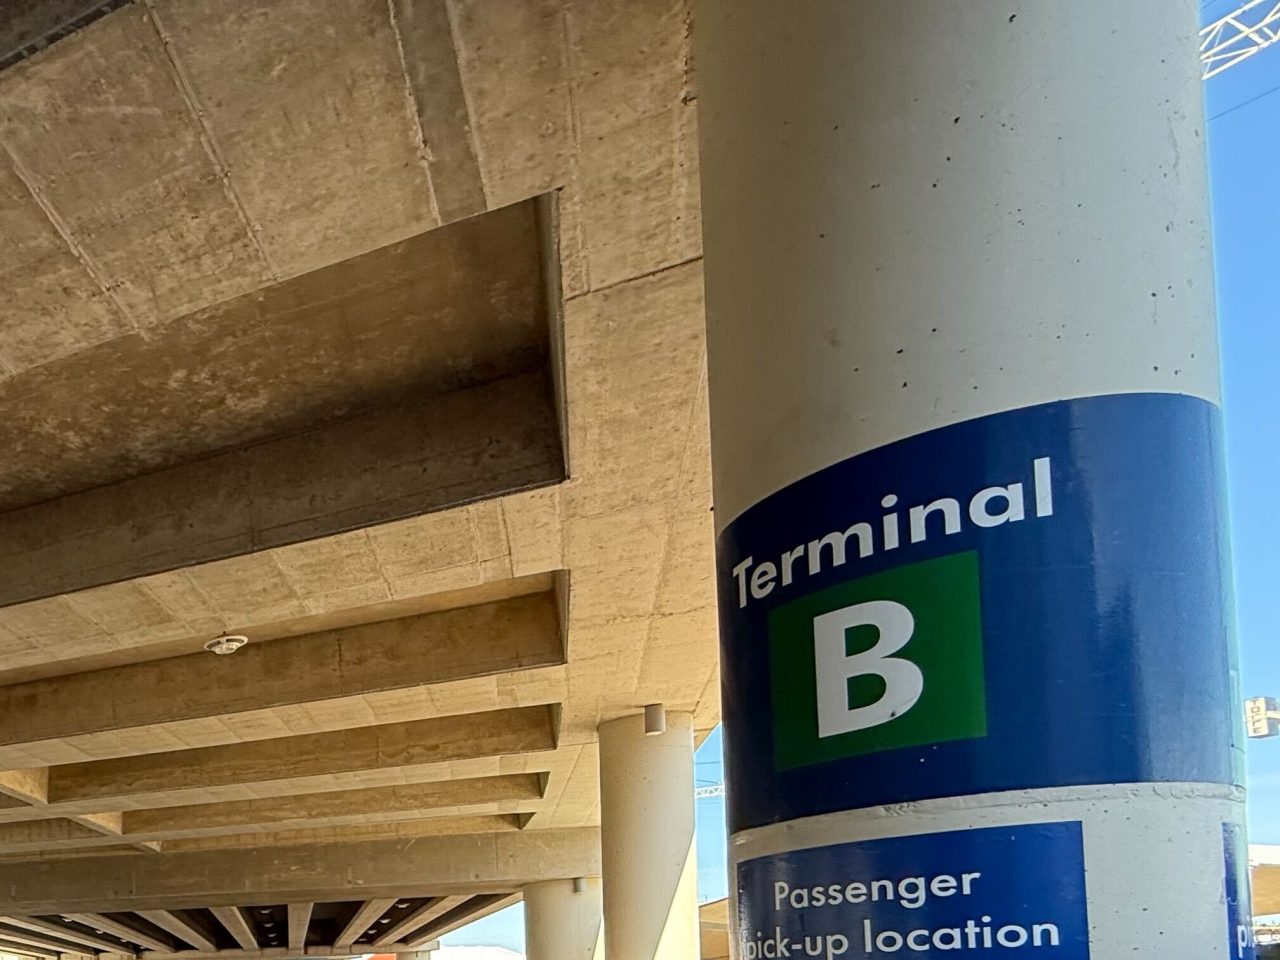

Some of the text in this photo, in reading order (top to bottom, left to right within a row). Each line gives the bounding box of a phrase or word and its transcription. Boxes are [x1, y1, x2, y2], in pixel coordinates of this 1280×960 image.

[732, 457, 1054, 608] Terminal
[812, 599, 925, 739] B
[774, 871, 981, 910] Passenger
[863, 917, 1061, 955] location
